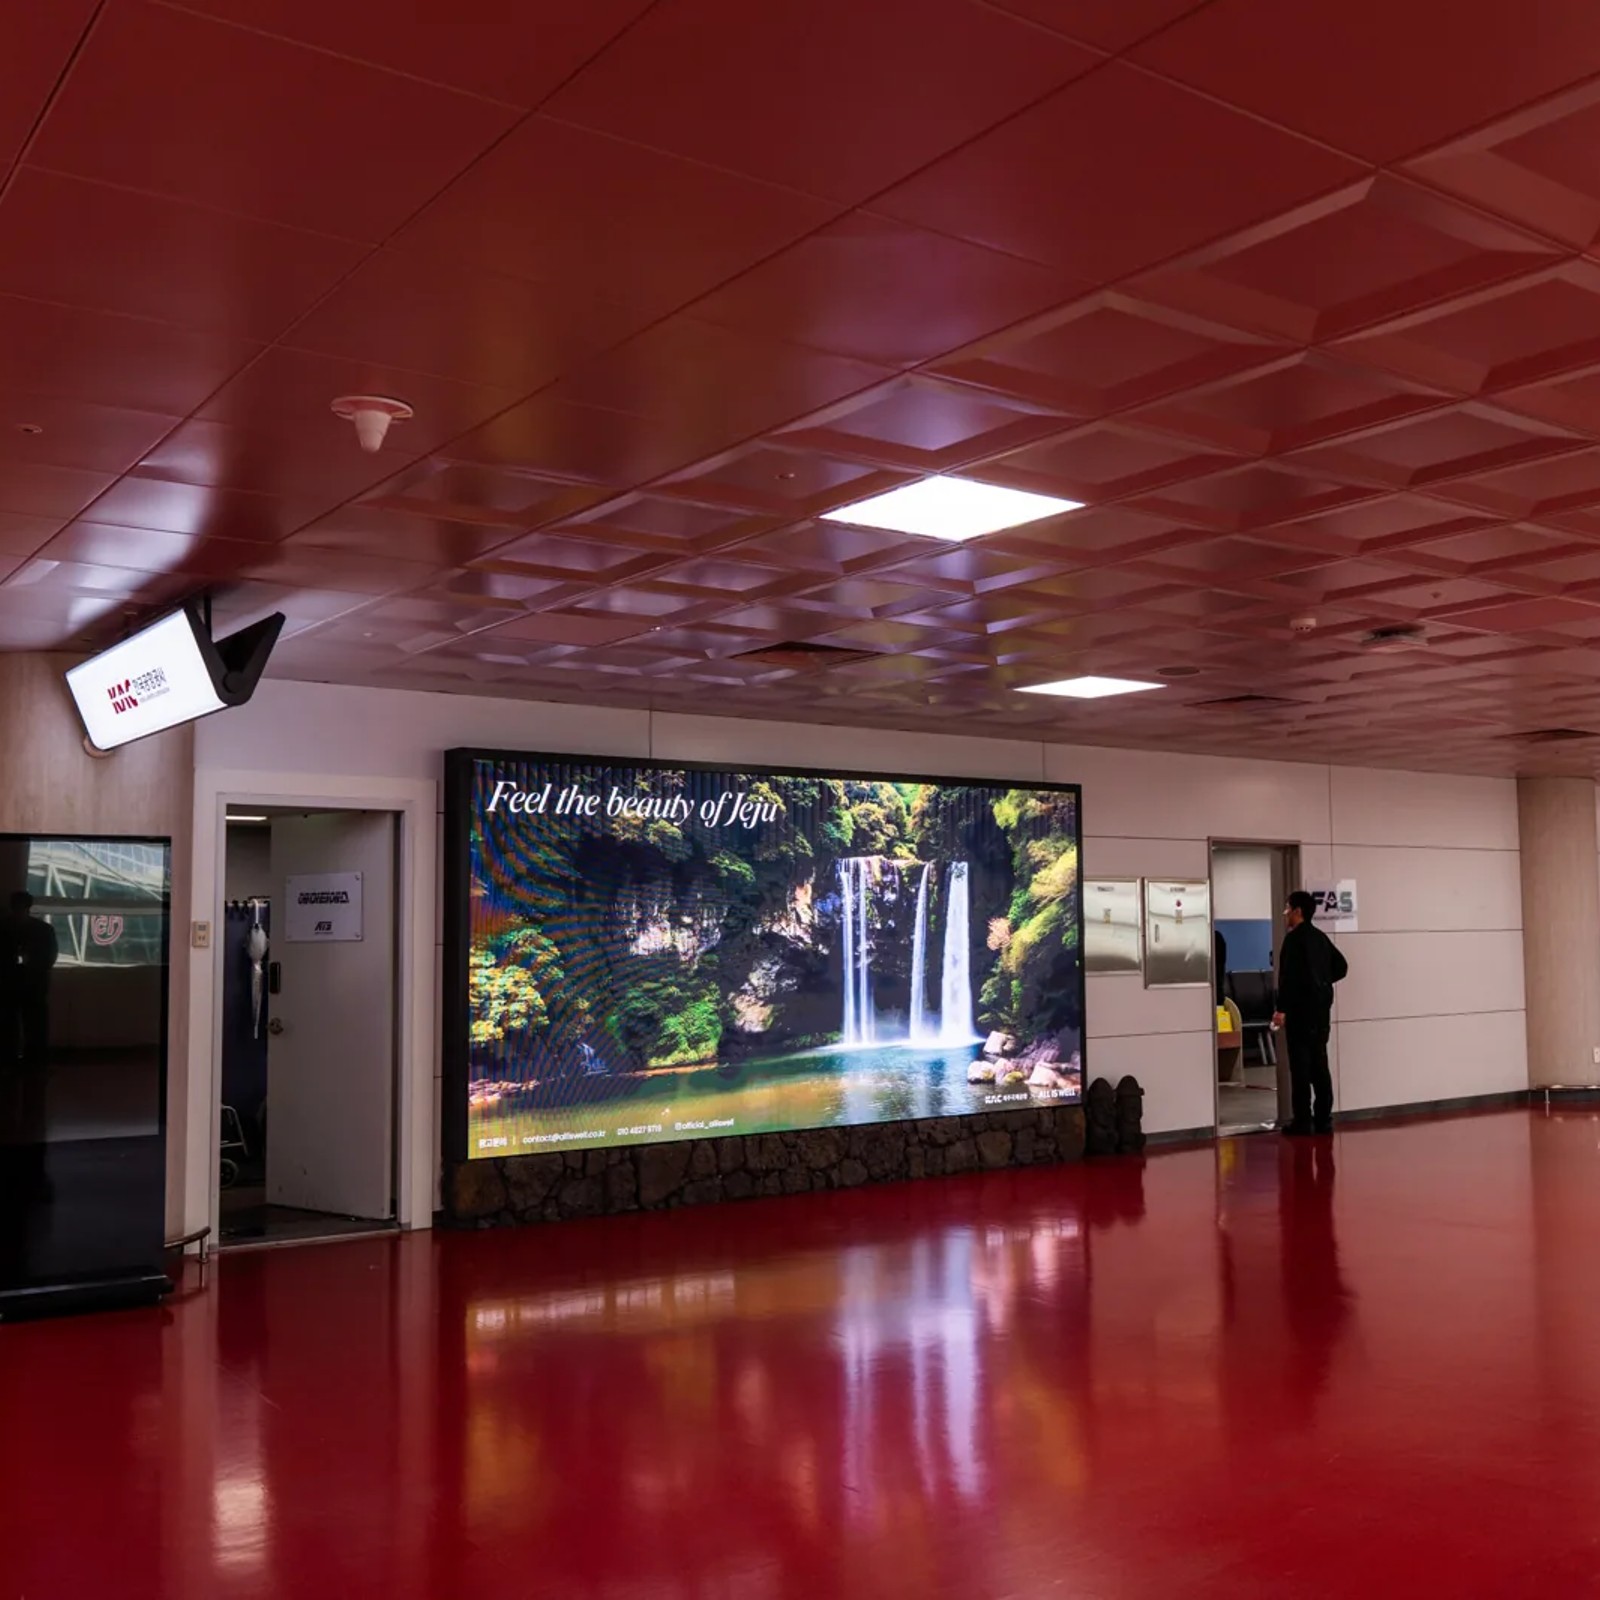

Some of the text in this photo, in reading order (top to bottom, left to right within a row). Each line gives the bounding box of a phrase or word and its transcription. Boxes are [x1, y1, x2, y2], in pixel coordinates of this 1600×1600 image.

[487, 781, 779, 829] Feel the beauty of Jeju
